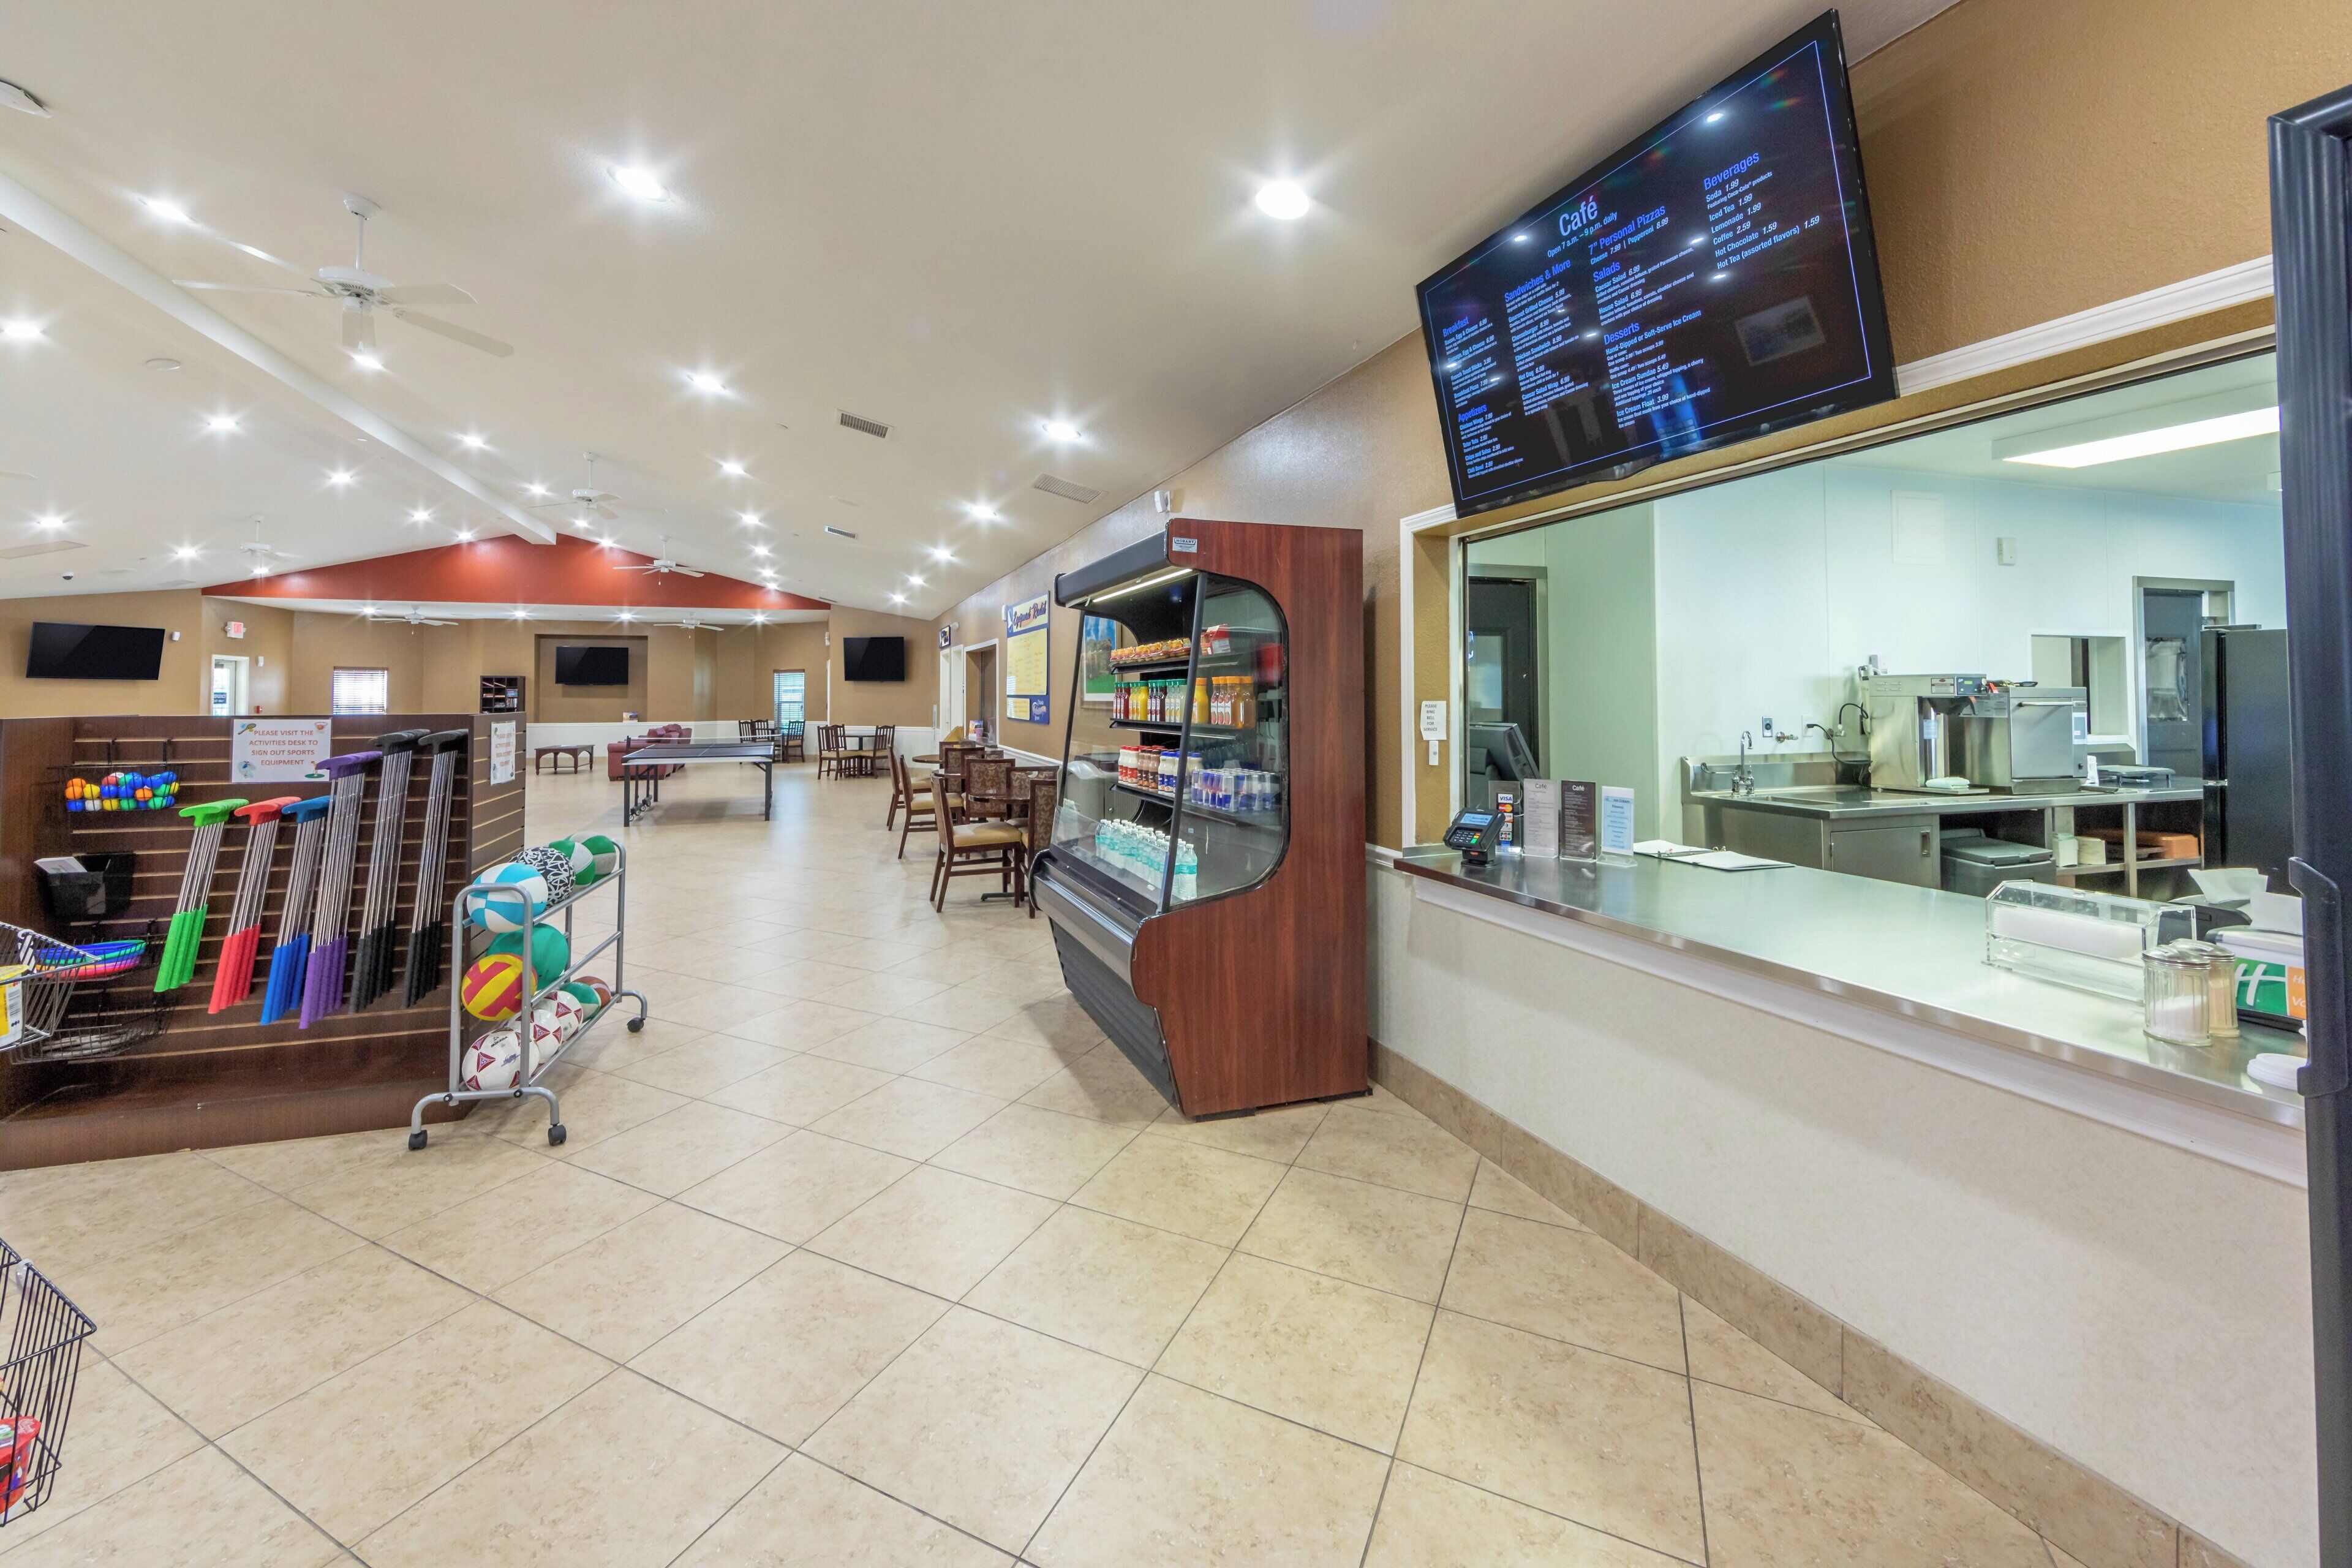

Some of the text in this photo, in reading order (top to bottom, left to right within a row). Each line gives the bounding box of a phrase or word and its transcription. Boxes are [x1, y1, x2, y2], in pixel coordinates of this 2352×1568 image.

[1703, 153, 1759, 190] Beverages
[1706, 178, 1738, 202] Soda 1.99
[1707, 195, 1727, 209] Featuring
[1752, 171, 1772, 186] products
[1559, 195, 1597, 236] Café
[1709, 193, 1752, 221] Iced Tea 1.99
[1711, 202, 1761, 233] Lemonade 1.99
[1547, 245, 1561, 257] Open
[1566, 236, 1578, 246] a.m.
[1589, 222, 1602, 235] p.m.
[1603, 211, 1617, 225] daily
[1590, 217, 1668, 265] Cheese 7.99 Pepperoni 8.99
[1599, 220, 1635, 249] Personal
[1637, 206, 1665, 228] Pizzas
[1713, 221, 1750, 244] Coffee 2.59
[1715, 221, 1777, 257] Hot Chocolate 1.59
[1717, 215, 1819, 269] Hot Tea (assorted flavors) 1.59
[1504, 259, 1570, 302] Sandwiches & More
[1593, 262, 1620, 282] Salads
[1595, 265, 1640, 292] Caesar Salad 6.99
[1508, 288, 1564, 322] Gourmet Grilled Cheese 5.99
[1599, 288, 1642, 314] House Salad 6.99
[1442, 316, 1469, 337] Breakfast
[1511, 318, 1548, 342] Cheeseburger 8.99
[1604, 323, 1640, 344] Desserts
[1605, 336, 1637, 355] Hand-Dipped
[1643, 322, 1672, 338] Soft-Serve
[1682, 310, 1701, 322] Cream
[1515, 334, 1561, 361] Chicken Sandwich 8.99
[1535, 364, 1544, 373] 6.99
[1619, 376, 1636, 386] Cream
[1636, 368, 1656, 380] Sundae
[1657, 362, 1668, 372] 5.49
[1521, 391, 1535, 400] Caesar
[1535, 385, 1547, 394] Salad
[1560, 375, 1570, 384] 6.99
[1458, 404, 1487, 422] Appetizers
[1624, 404, 1641, 413] Cream
[1641, 398, 1655, 408] Float
[1657, 393, 1668, 402] 3.99
[1014, 600, 1047, 629] Equipment Rental
